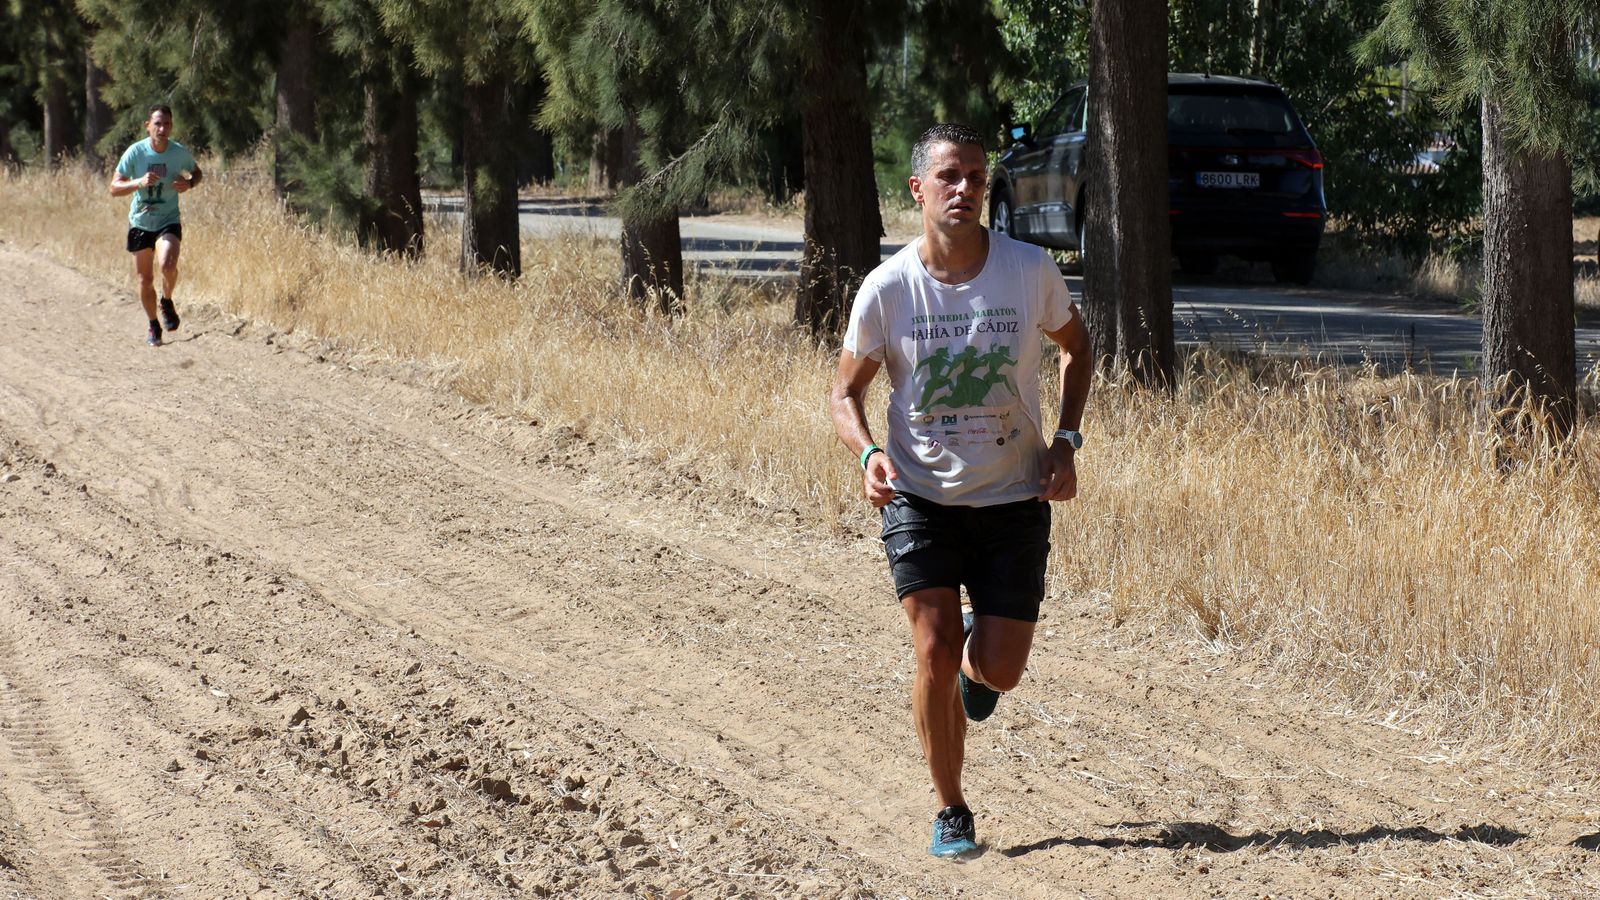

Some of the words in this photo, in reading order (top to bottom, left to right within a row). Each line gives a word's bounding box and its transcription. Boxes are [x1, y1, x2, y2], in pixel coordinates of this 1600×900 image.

[1235, 174, 1258, 186] LRK
[938, 313, 969, 323] MEDIA
[954, 325, 972, 337] DE
[977, 319, 1019, 333] CÁDIZ
